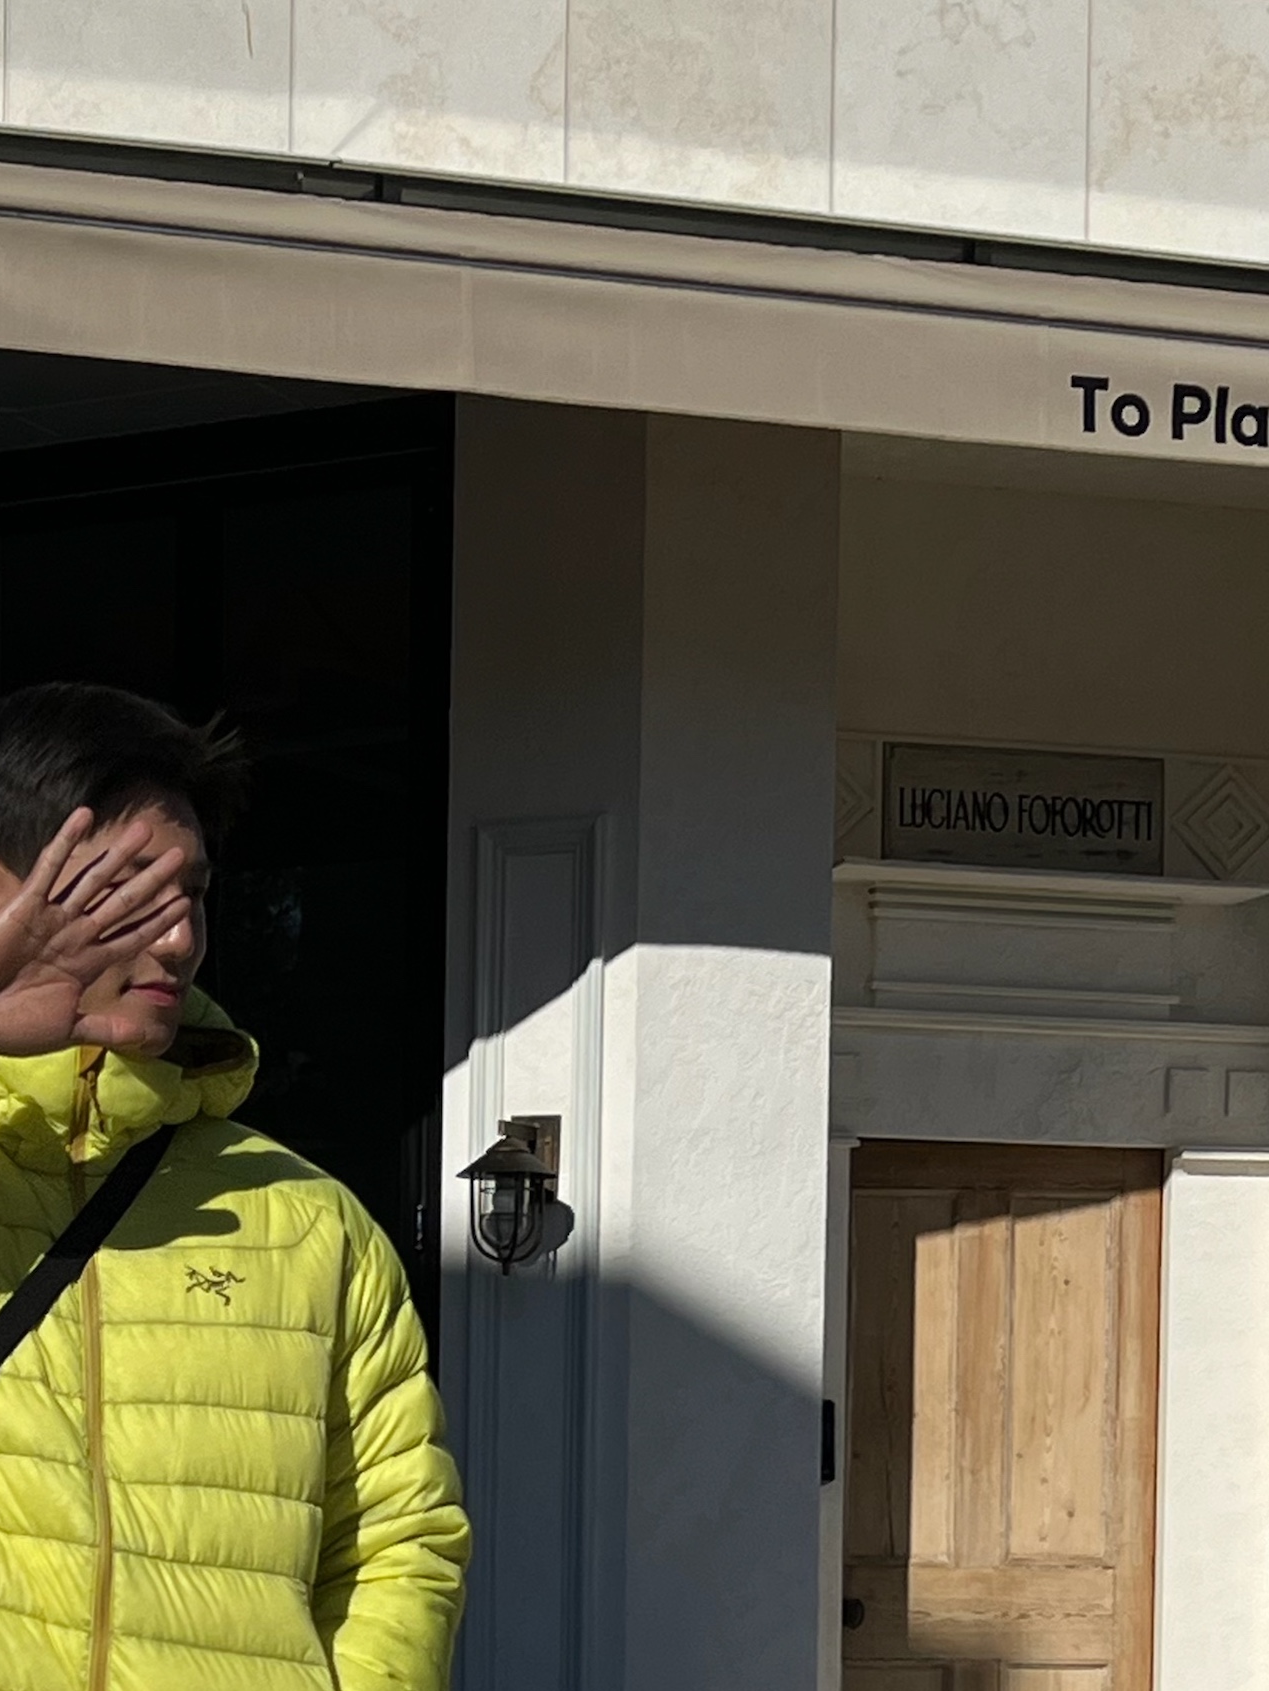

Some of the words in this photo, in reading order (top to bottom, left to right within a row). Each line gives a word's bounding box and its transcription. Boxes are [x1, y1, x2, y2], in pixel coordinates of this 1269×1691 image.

[1071, 375, 1150, 437] To
[1172, 383, 1269, 447] Pla
[899, 786, 1009, 833] LUCIANO
[1017, 794, 1153, 841] FOFOROTTI
